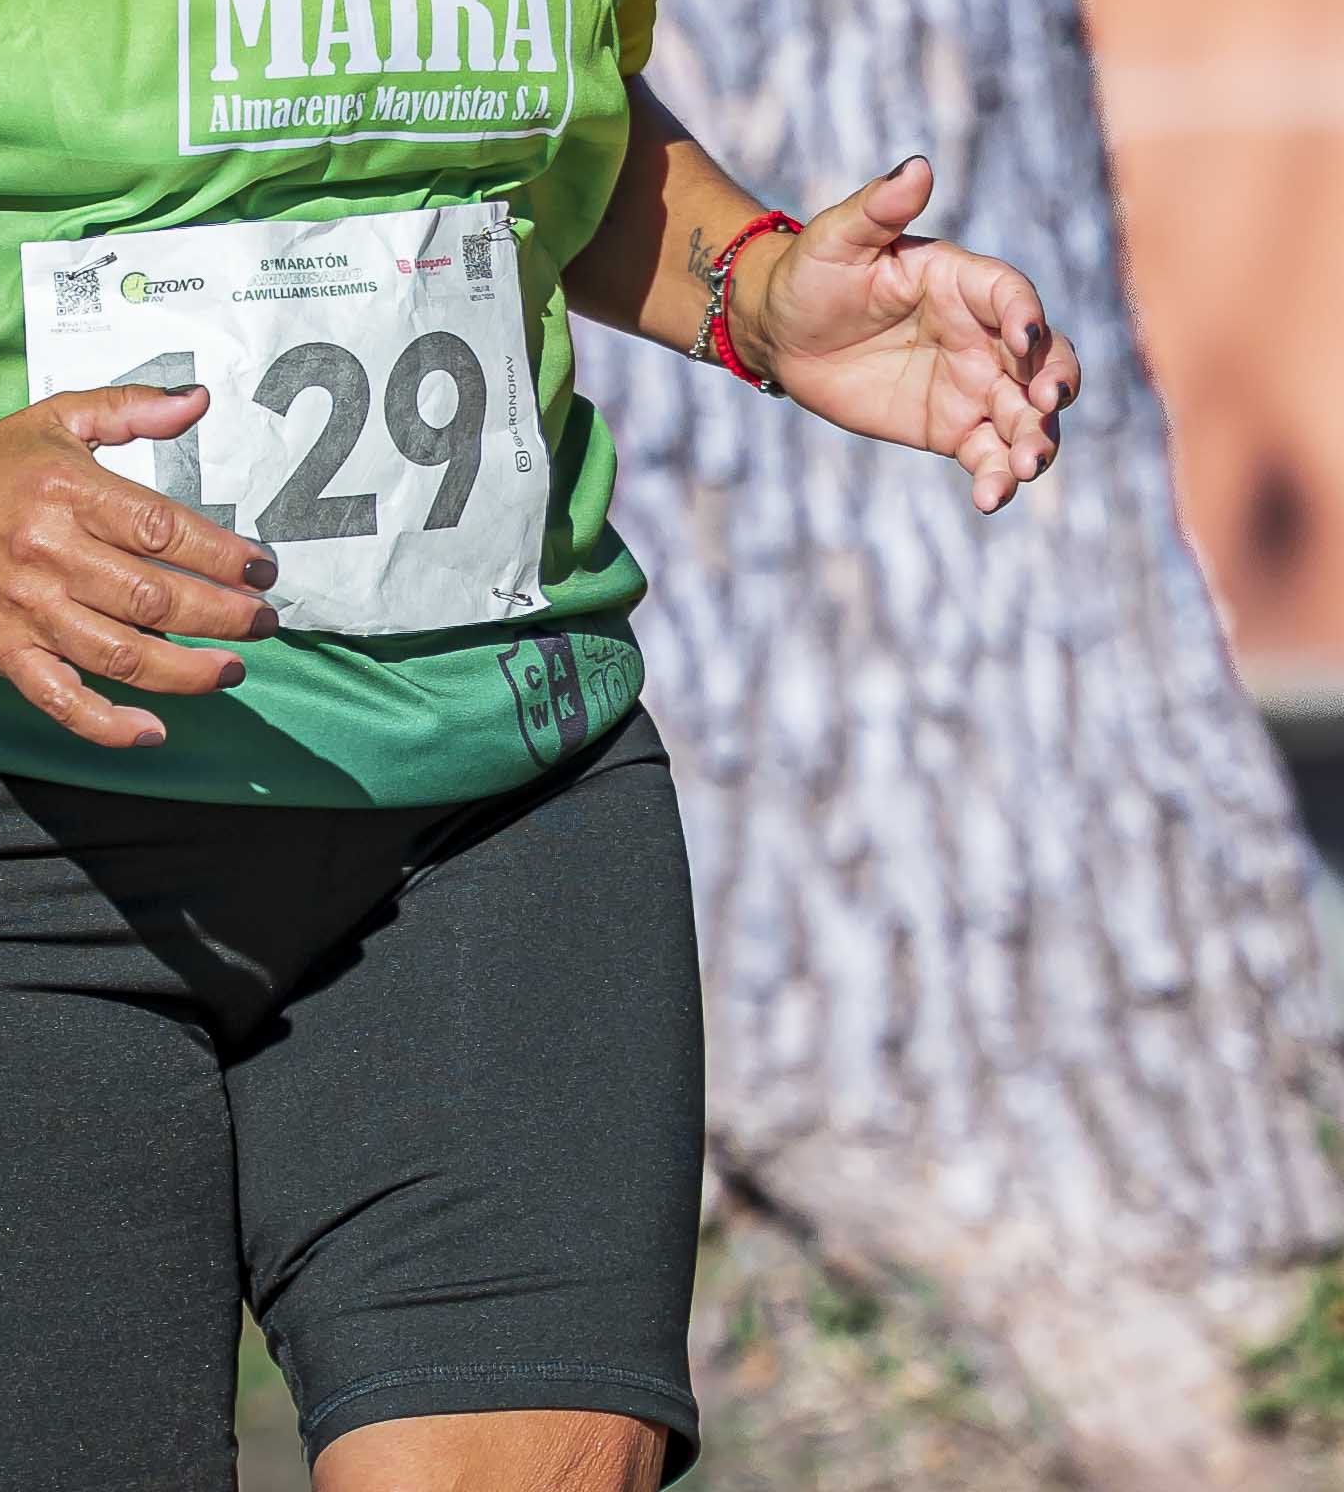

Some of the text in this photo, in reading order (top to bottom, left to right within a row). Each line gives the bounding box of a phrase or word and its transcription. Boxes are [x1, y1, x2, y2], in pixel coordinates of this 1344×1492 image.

[210, 85, 552, 133] Almacenes Mayoristas S.A.
[232, 281, 378, 302] CAWILLIAMSKEMMIS
[505, 355, 524, 447] @CRONORAV
